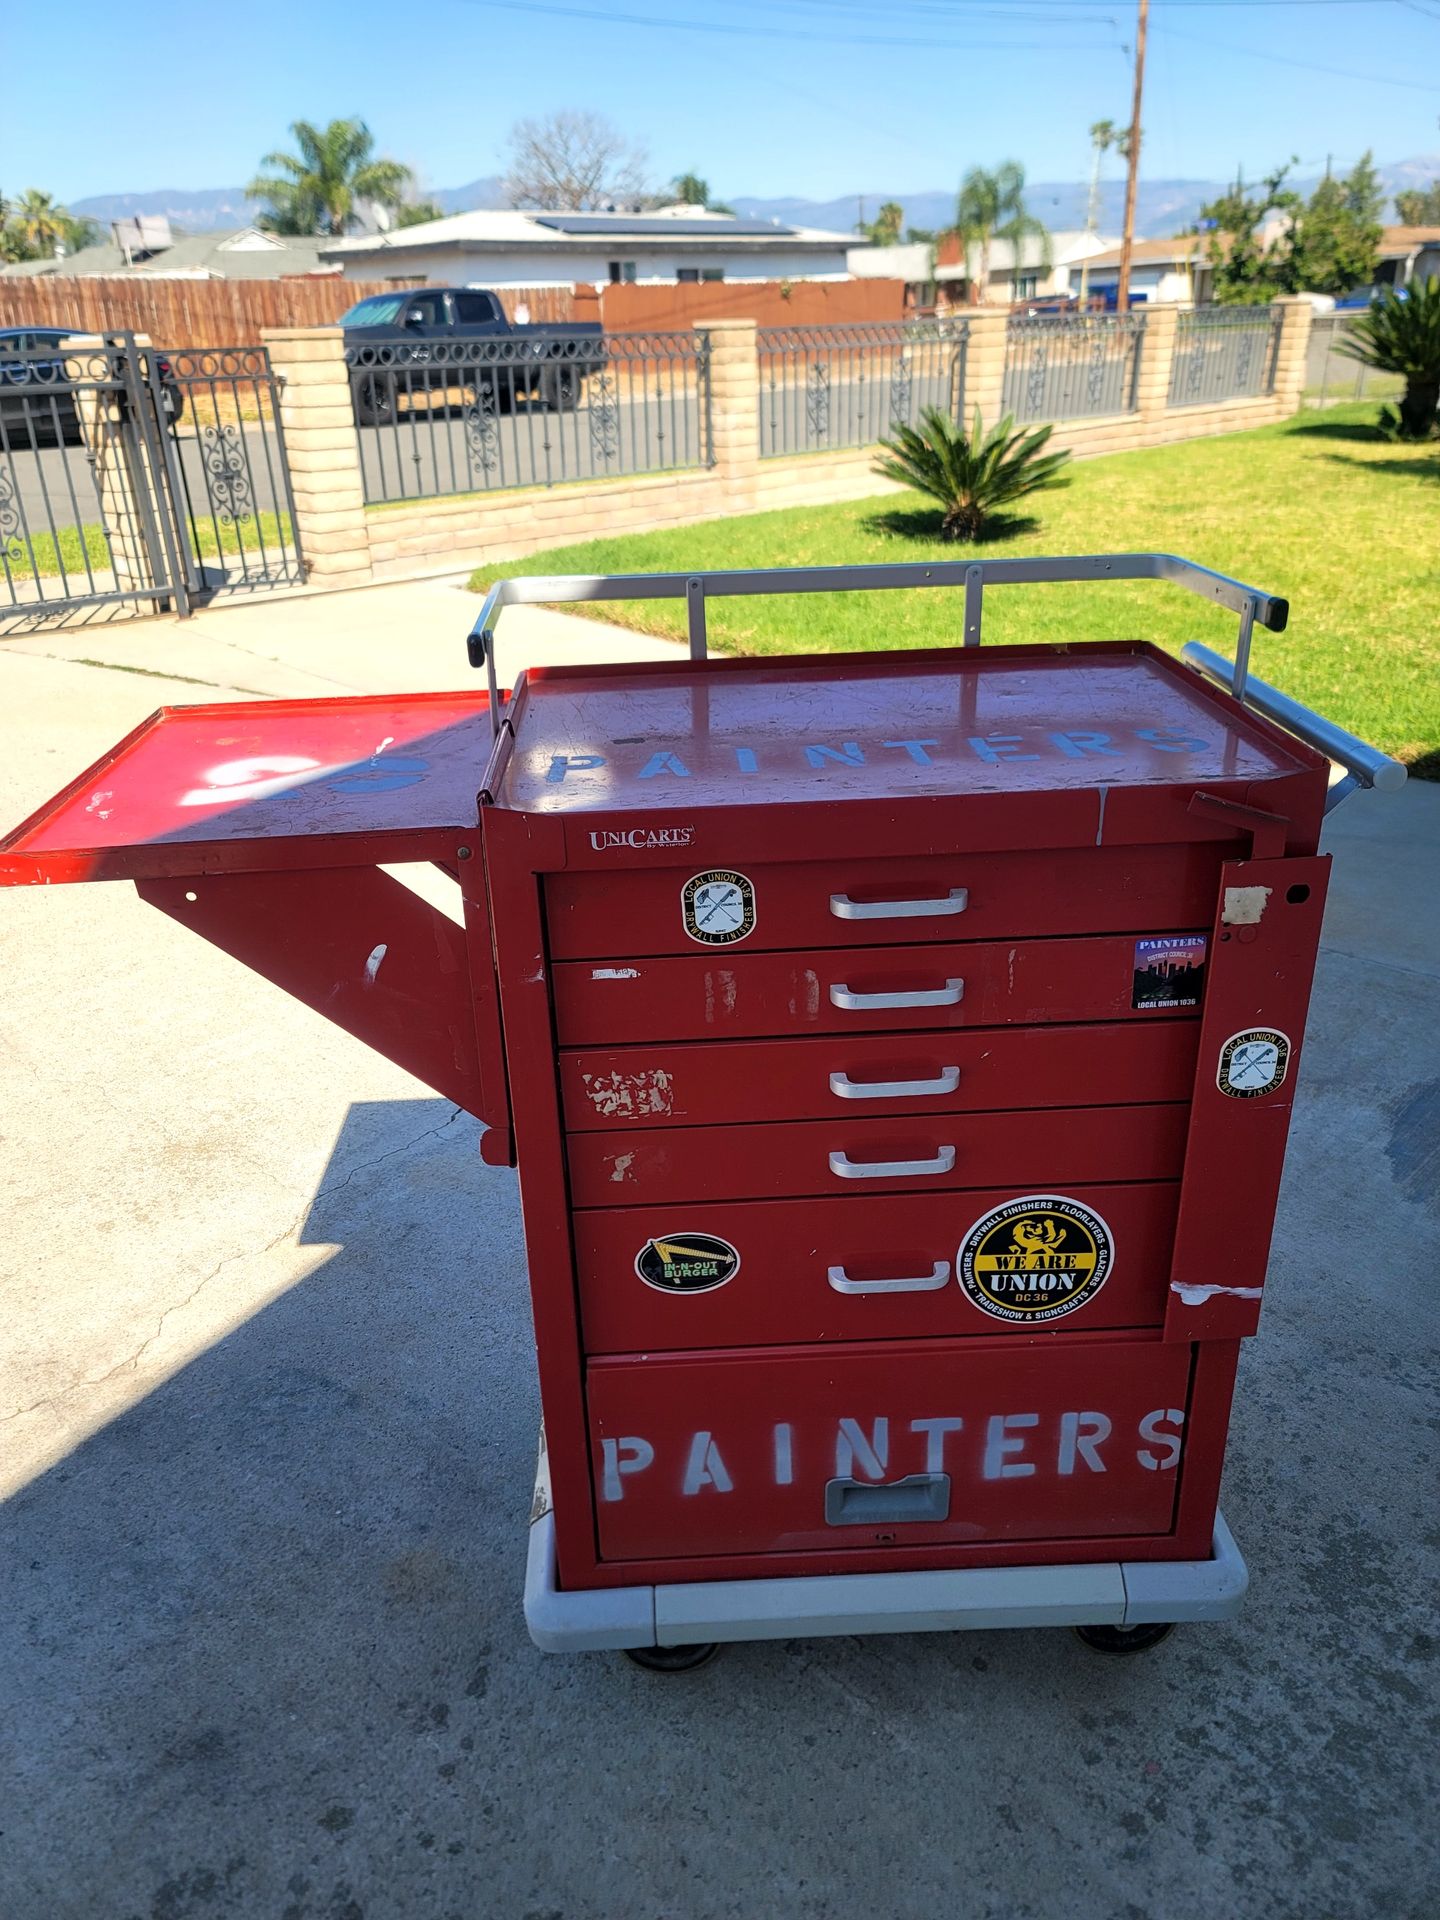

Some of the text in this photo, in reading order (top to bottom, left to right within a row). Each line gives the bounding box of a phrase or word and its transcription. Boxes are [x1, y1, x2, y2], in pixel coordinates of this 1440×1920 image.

[545, 726, 1212, 783] PAINTERS
[685, 873, 752, 903] LOCAL UNION 1136
[686, 906, 753, 942] DRYWALL FINISHERS
[1139, 937, 1205, 950] PAINTERS
[1137, 1001, 1157, 1009] LOCAL
[1223, 1033, 1288, 1060] LOCAL UNION 1136
[1220, 1065, 1285, 1097] DRYWALL FINISHERS
[971, 1201, 1053, 1247] DRYWALL FINISHERS
[1060, 1204, 1106, 1245] FLOORLAYERS
[664, 1261, 718, 1271] IN-N-OUT
[664, 1268, 720, 1278] BURGER
[963, 1251, 977, 1290] PAINTERS
[995, 1254, 1077, 1270] WE ARE
[1089, 1249, 1108, 1288] GLAZIERS
[990, 1273, 1077, 1292] UNION
[1015, 1293, 1049, 1302] DC 36
[975, 1290, 1089, 1320] TRADESHOW & SIGNCRAFTS
[602, 1408, 1185, 1501] PAINTERS
